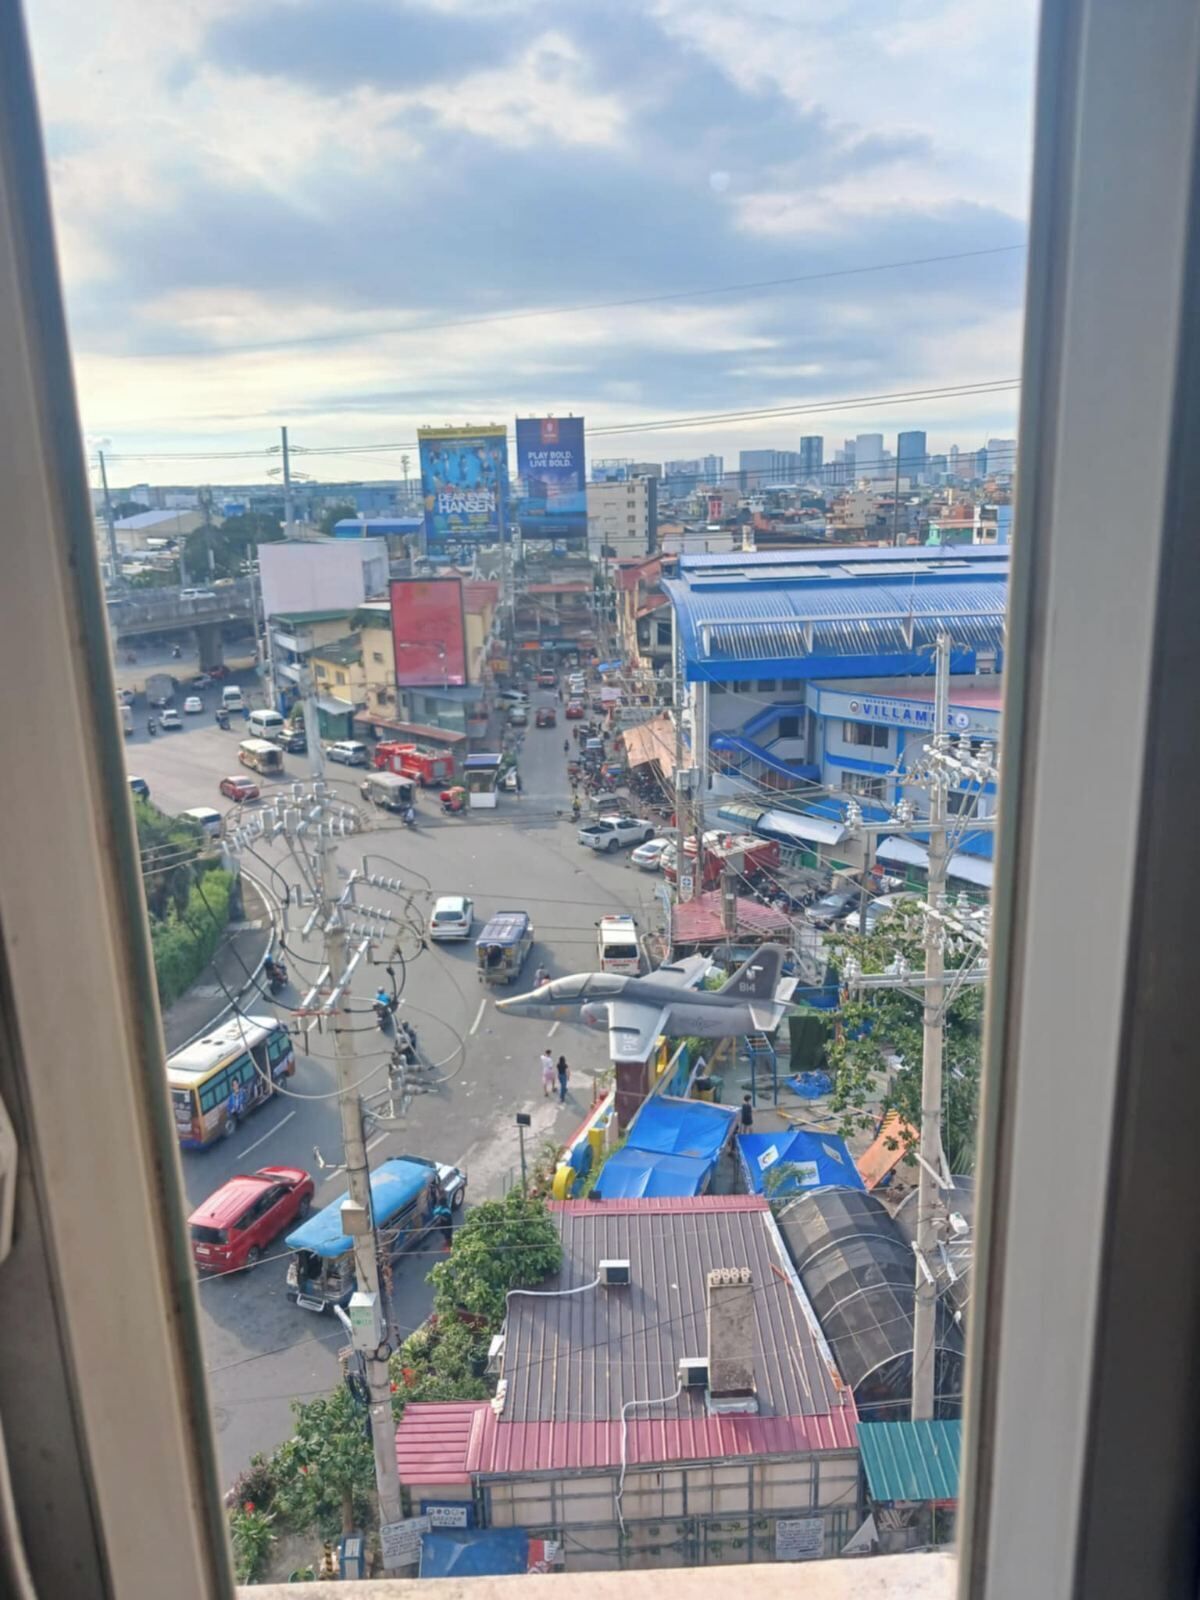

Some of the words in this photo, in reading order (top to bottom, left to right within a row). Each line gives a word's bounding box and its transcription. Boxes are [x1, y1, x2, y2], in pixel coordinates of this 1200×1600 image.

[528, 451, 549, 459] PLAY
[550, 451, 574, 459] BOLD.
[529, 460, 547, 468] LIVE
[549, 459, 573, 467] BOLD.
[439, 501, 497, 514] HANSEN
[863, 702, 956, 726] VILLAMR
